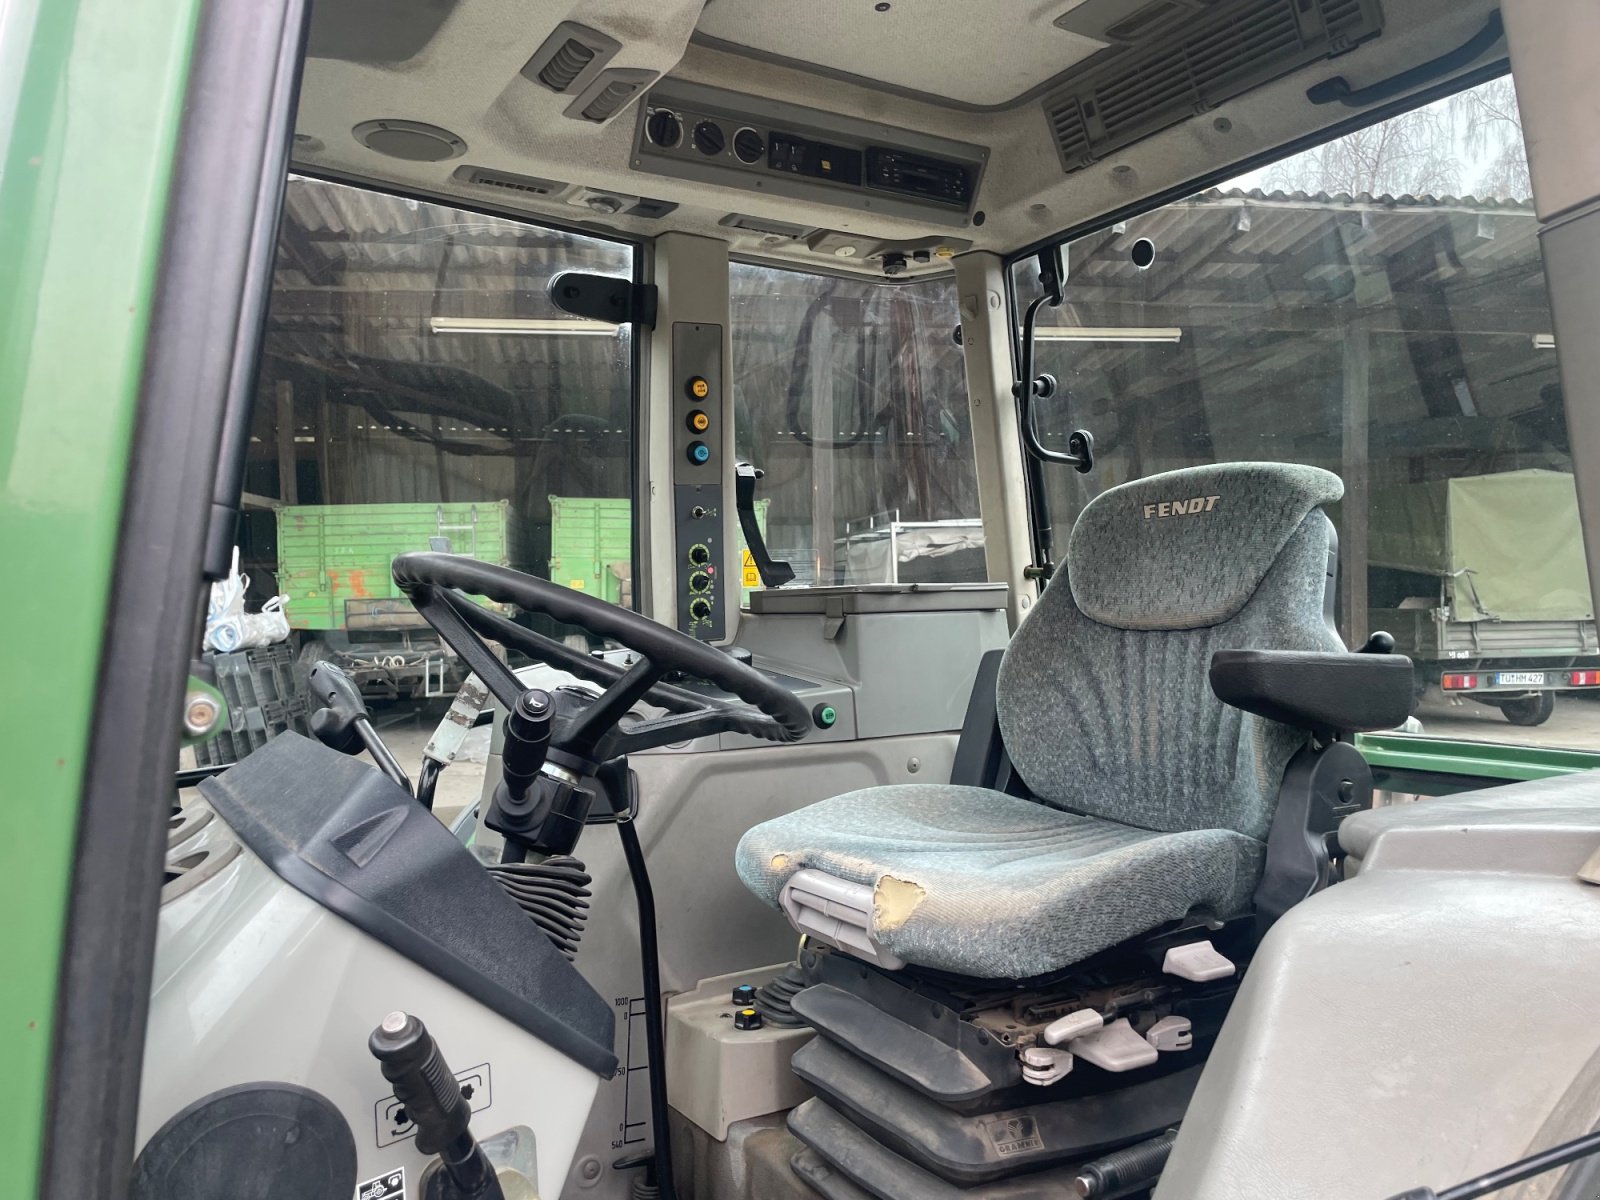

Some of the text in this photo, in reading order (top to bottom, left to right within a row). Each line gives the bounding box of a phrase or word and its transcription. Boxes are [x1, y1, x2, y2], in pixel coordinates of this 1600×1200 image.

[1144, 495, 1220, 519] FENDT
[615, 997, 629, 1007] 1000
[611, 1141, 624, 1150] 540
